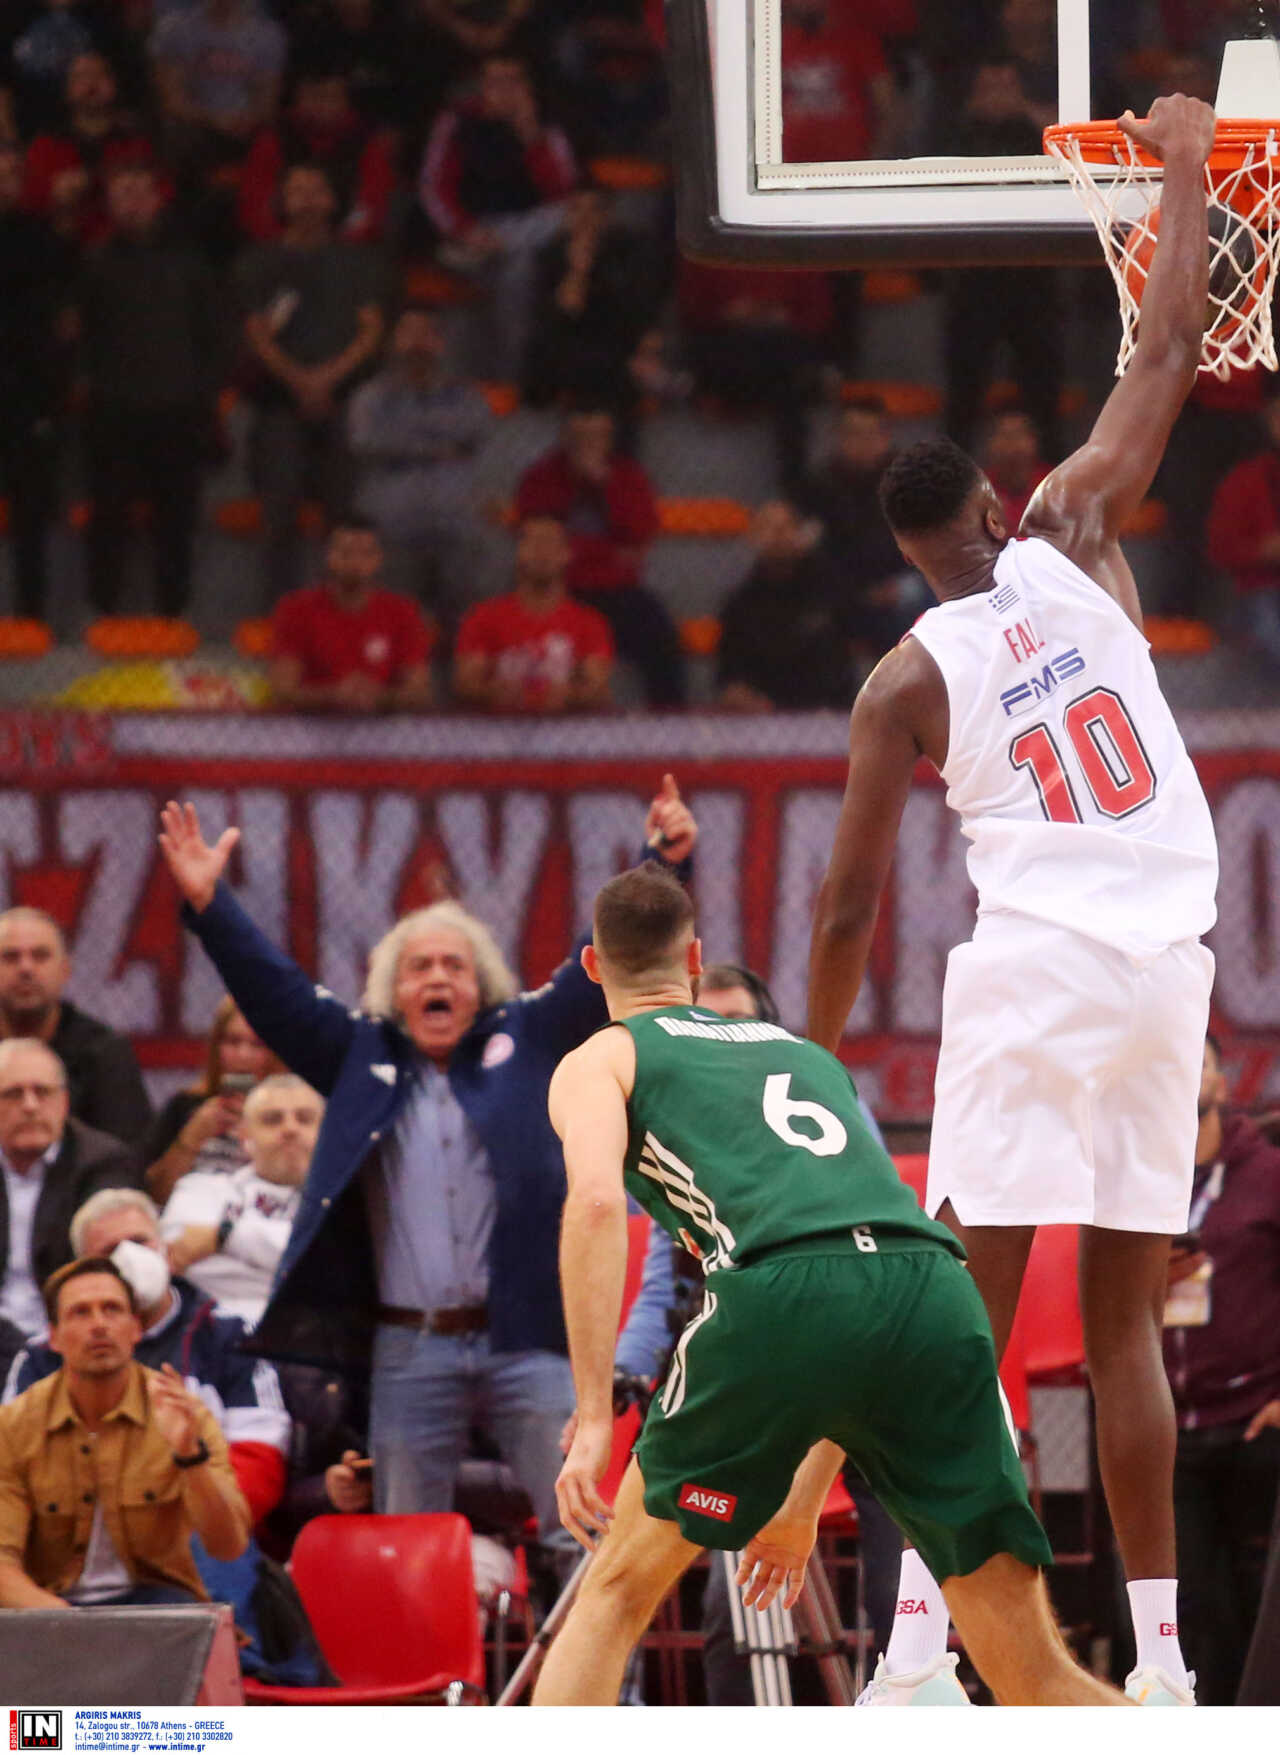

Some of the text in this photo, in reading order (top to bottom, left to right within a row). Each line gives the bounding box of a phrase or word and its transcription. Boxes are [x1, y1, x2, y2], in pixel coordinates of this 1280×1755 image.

[1000, 647, 1086, 717] FMS
[1009, 685, 1157, 822] 10
[762, 1072, 848, 1157] 6
[852, 1224, 888, 1253] 6
[686, 1491, 729, 1515] AVIS
